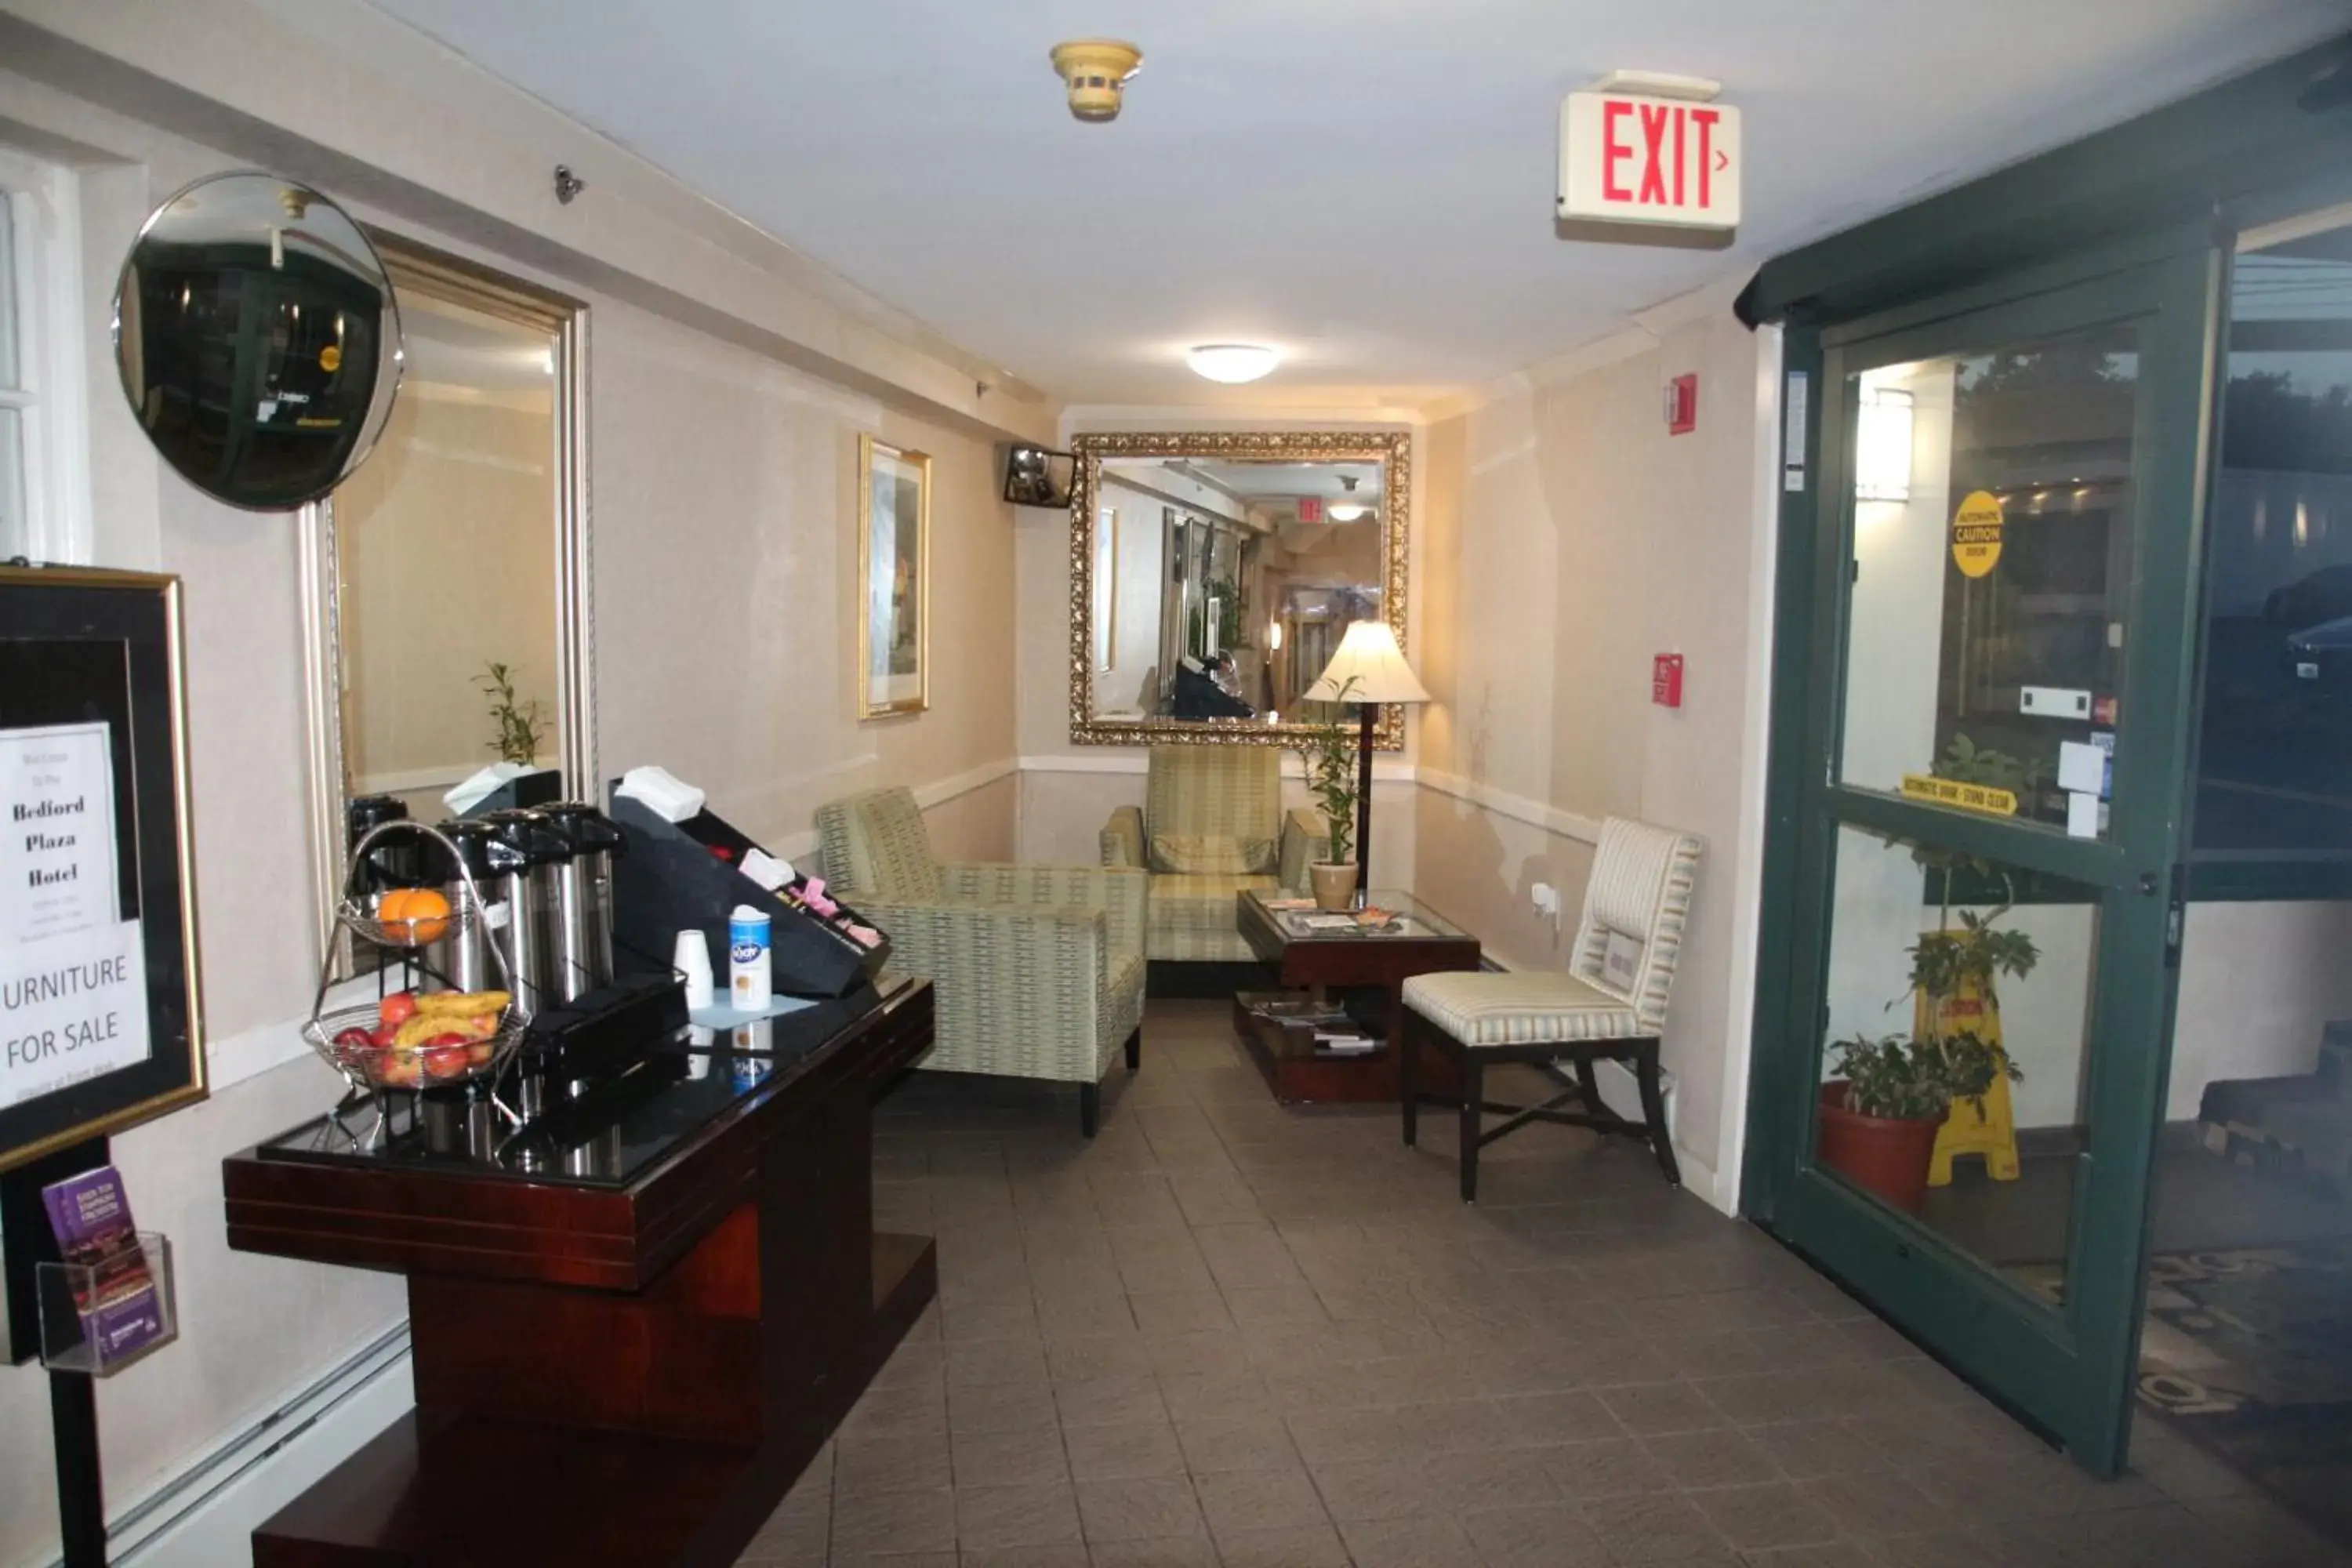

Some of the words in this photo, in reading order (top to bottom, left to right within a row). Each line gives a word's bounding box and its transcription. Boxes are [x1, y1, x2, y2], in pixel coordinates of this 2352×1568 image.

[1603, 100, 1719, 209] EXIT
[1955, 526, 2001, 543] CAUTION
[13, 795, 85, 822] Bedford
[26, 833, 76, 852] Plaza
[29, 863, 77, 887] Hotel
[7, 1029, 59, 1069] FOR
[64, 1011, 119, 1051] SALE
